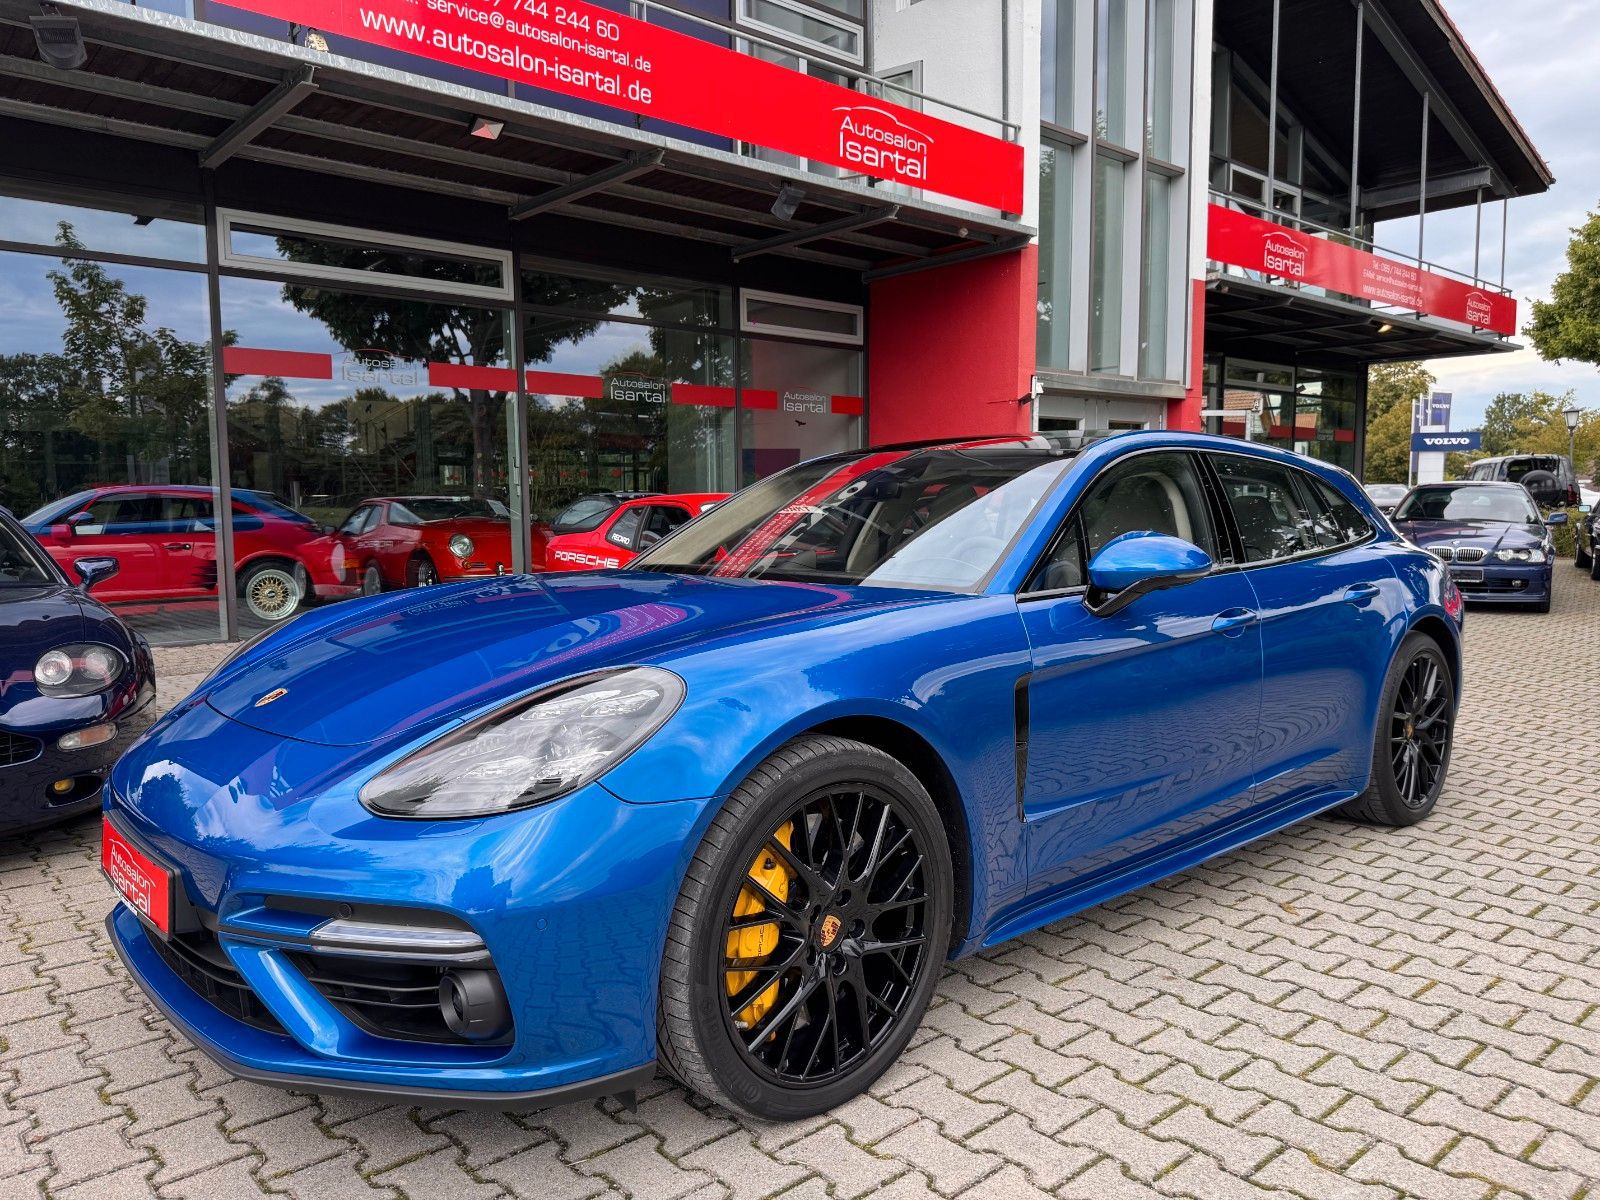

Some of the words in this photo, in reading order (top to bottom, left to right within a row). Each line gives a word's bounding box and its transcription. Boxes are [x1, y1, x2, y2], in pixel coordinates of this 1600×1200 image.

[555, 6, 591, 33] 244
[596, 19, 620, 41] 60
[426, 0, 652, 73] service@autosalon-isartal.de
[359, 7, 652, 105] www.autosalon-isartal.de
[840, 115, 927, 153] Autosalon
[839, 131, 927, 180] Isartal
[1265, 239, 1305, 259] Autosalon
[1264, 249, 1305, 276] Isartal
[1466, 298, 1492, 311] Autosalon
[1466, 305, 1491, 325] Isartal
[610, 386, 666, 403] Isartal
[611, 377, 665, 390] Autosalon
[783, 399, 826, 414] Isartal
[784, 391, 826, 401] Autosalon
[554, 551, 620, 569] PORSCHE
[112, 843, 150, 890] Autosalon
[110, 853, 151, 918] Isartal
